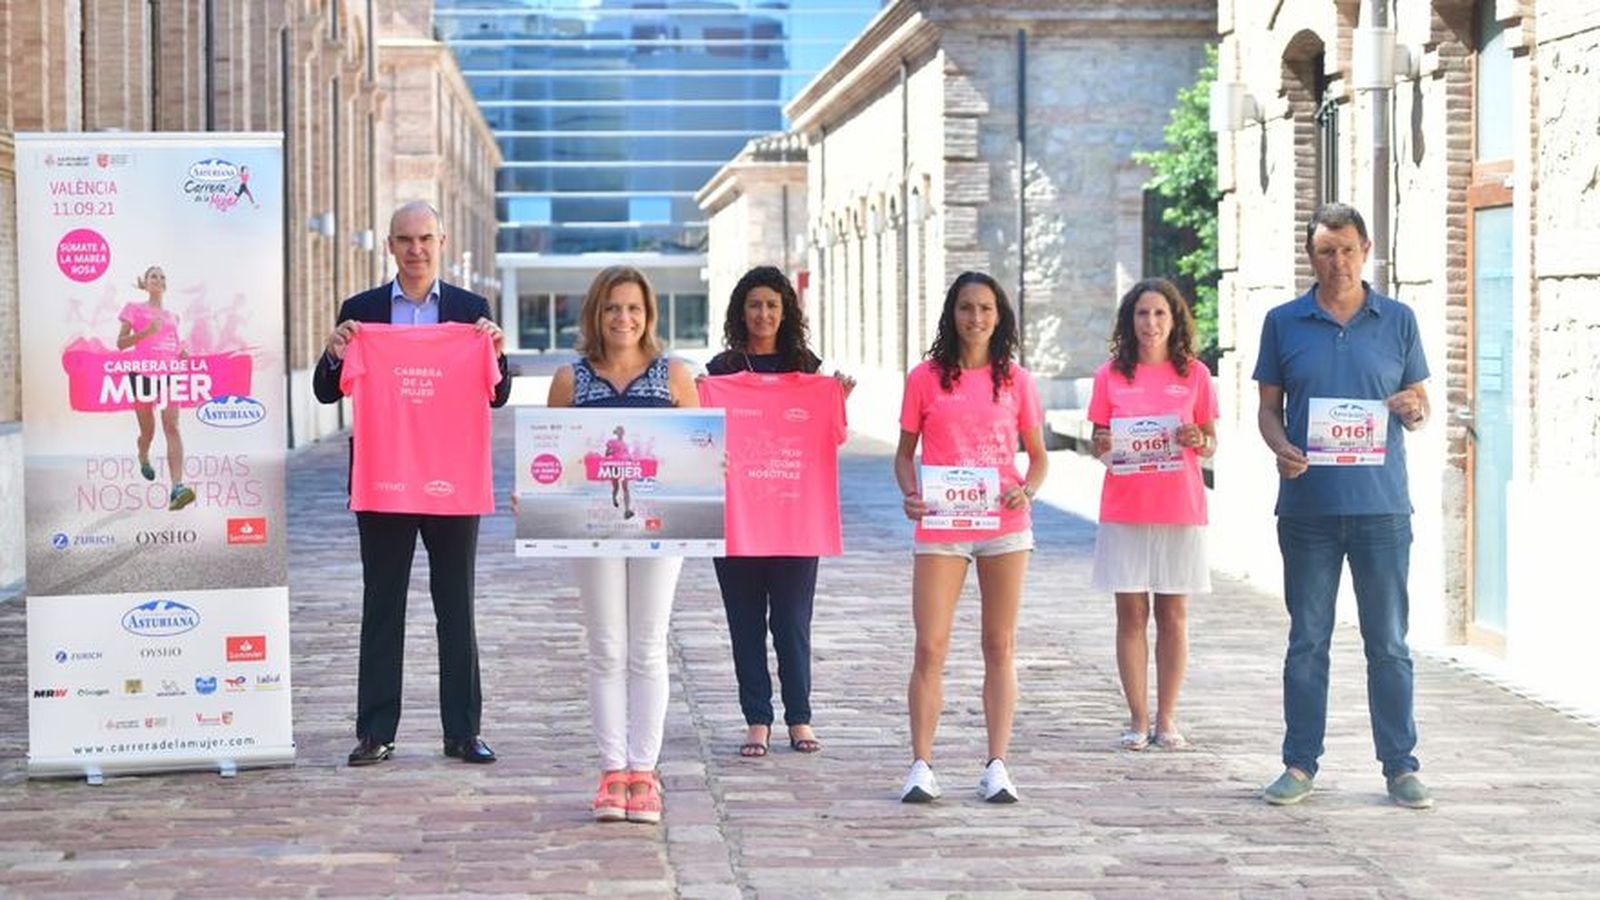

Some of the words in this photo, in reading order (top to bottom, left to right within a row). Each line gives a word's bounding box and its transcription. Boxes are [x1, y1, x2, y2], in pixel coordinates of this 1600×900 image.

[50, 179, 118, 196] VALÈNCIA
[53, 202, 115, 216] 11.09.21
[100, 243, 108, 252] A
[60, 254, 71, 264] LA
[104, 360, 167, 372] CARRERA
[170, 360, 188, 371] DE
[191, 359, 208, 371] LA
[420, 378, 434, 387] LA
[99, 374, 212, 410] MUJER
[203, 406, 260, 420] ASTURIANA
[1331, 425, 1366, 439] 016
[1132, 437, 1162, 452] 016
[86, 457, 134, 481] POR
[597, 466, 642, 481] MUJER
[945, 488, 978, 502] 016
[73, 534, 115, 546] ZURICH
[135, 530, 197, 546] OYSHO
[128, 615, 195, 630] ASTURIANA
[70, 651, 103, 661] ZURICH
[140, 647, 182, 658] OYSHO
[34, 689, 68, 698] MRW
[73, 737, 256, 755] www.carreradelamujer.com
